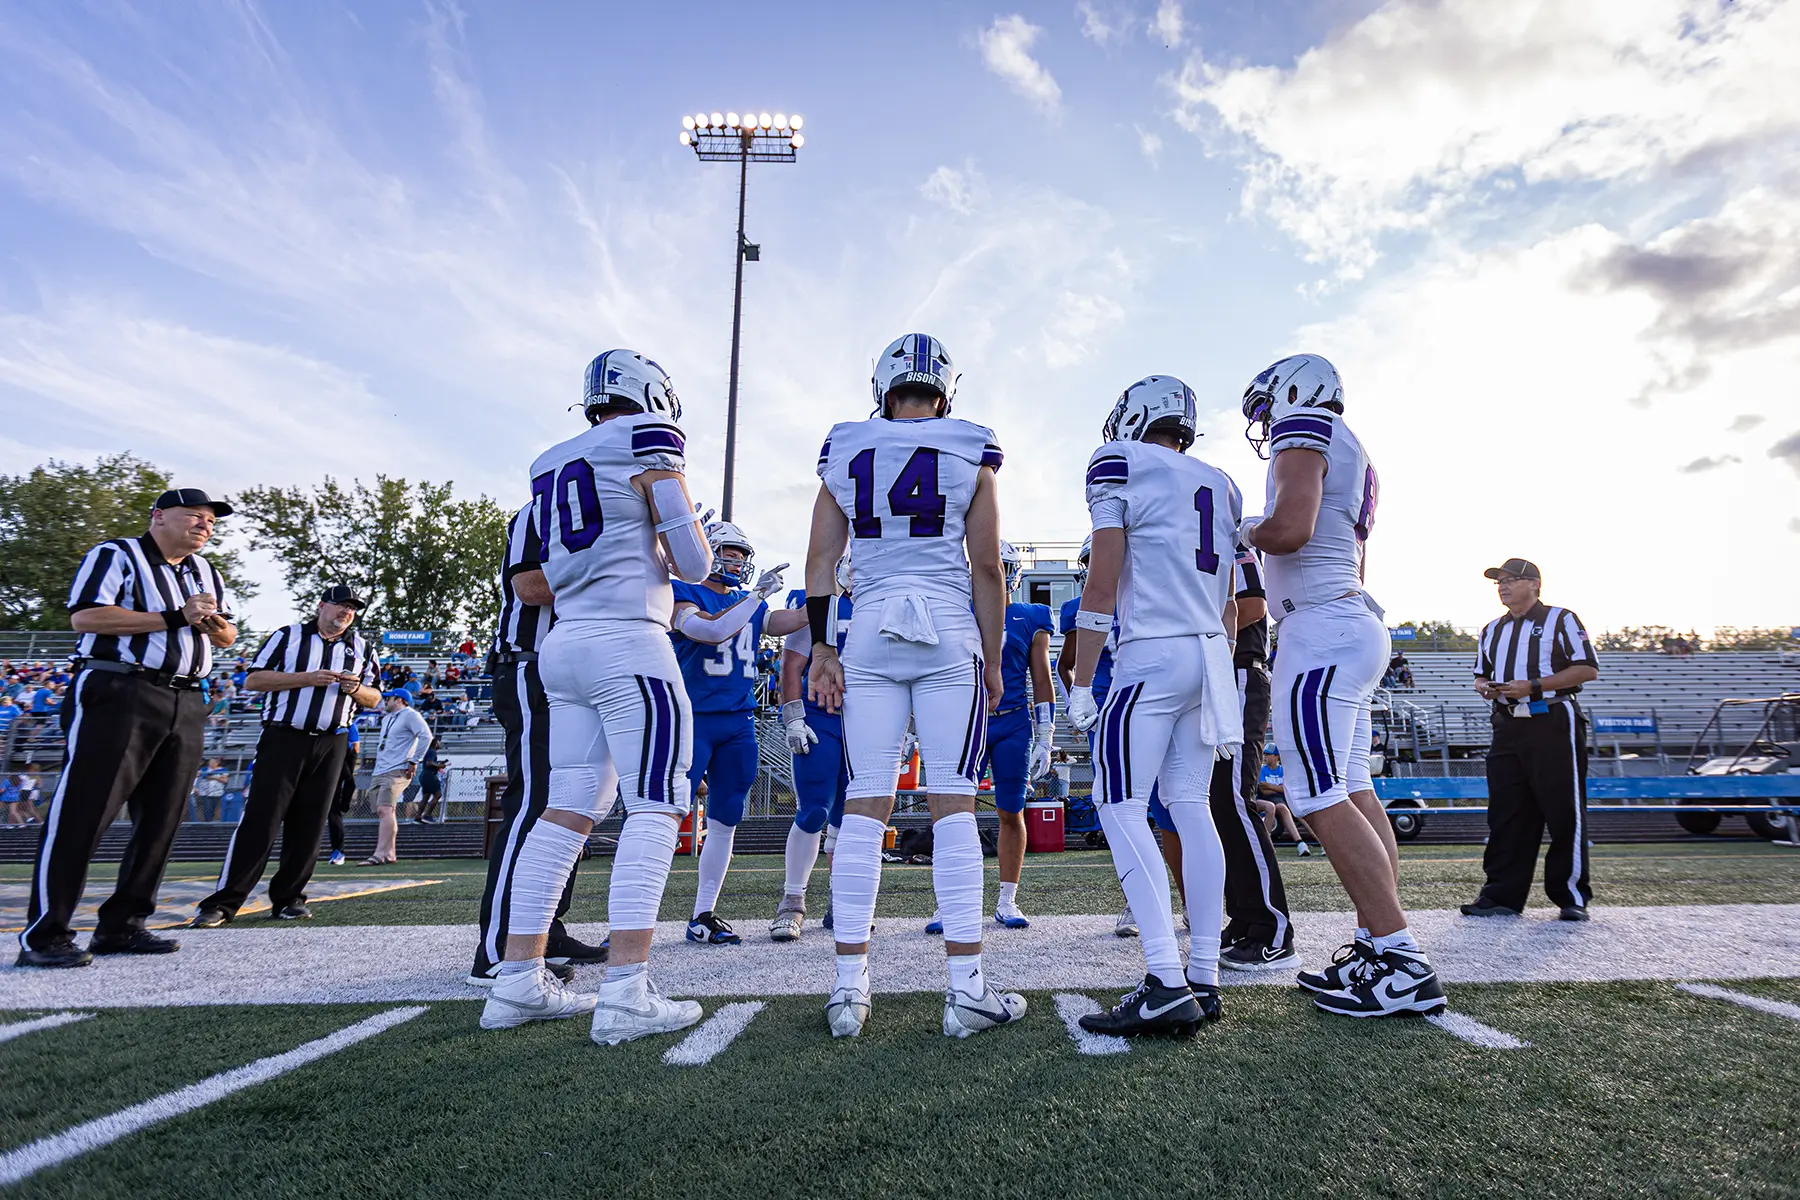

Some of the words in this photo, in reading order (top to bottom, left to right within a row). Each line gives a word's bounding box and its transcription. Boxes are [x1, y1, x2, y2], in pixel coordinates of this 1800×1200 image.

[906, 371, 936, 385] BISON
[532, 457, 604, 563] 70
[849, 446, 946, 538] 14
[1194, 485, 1219, 575] 1
[703, 622, 755, 678] 34
[1598, 719, 1632, 727] VISITOR
